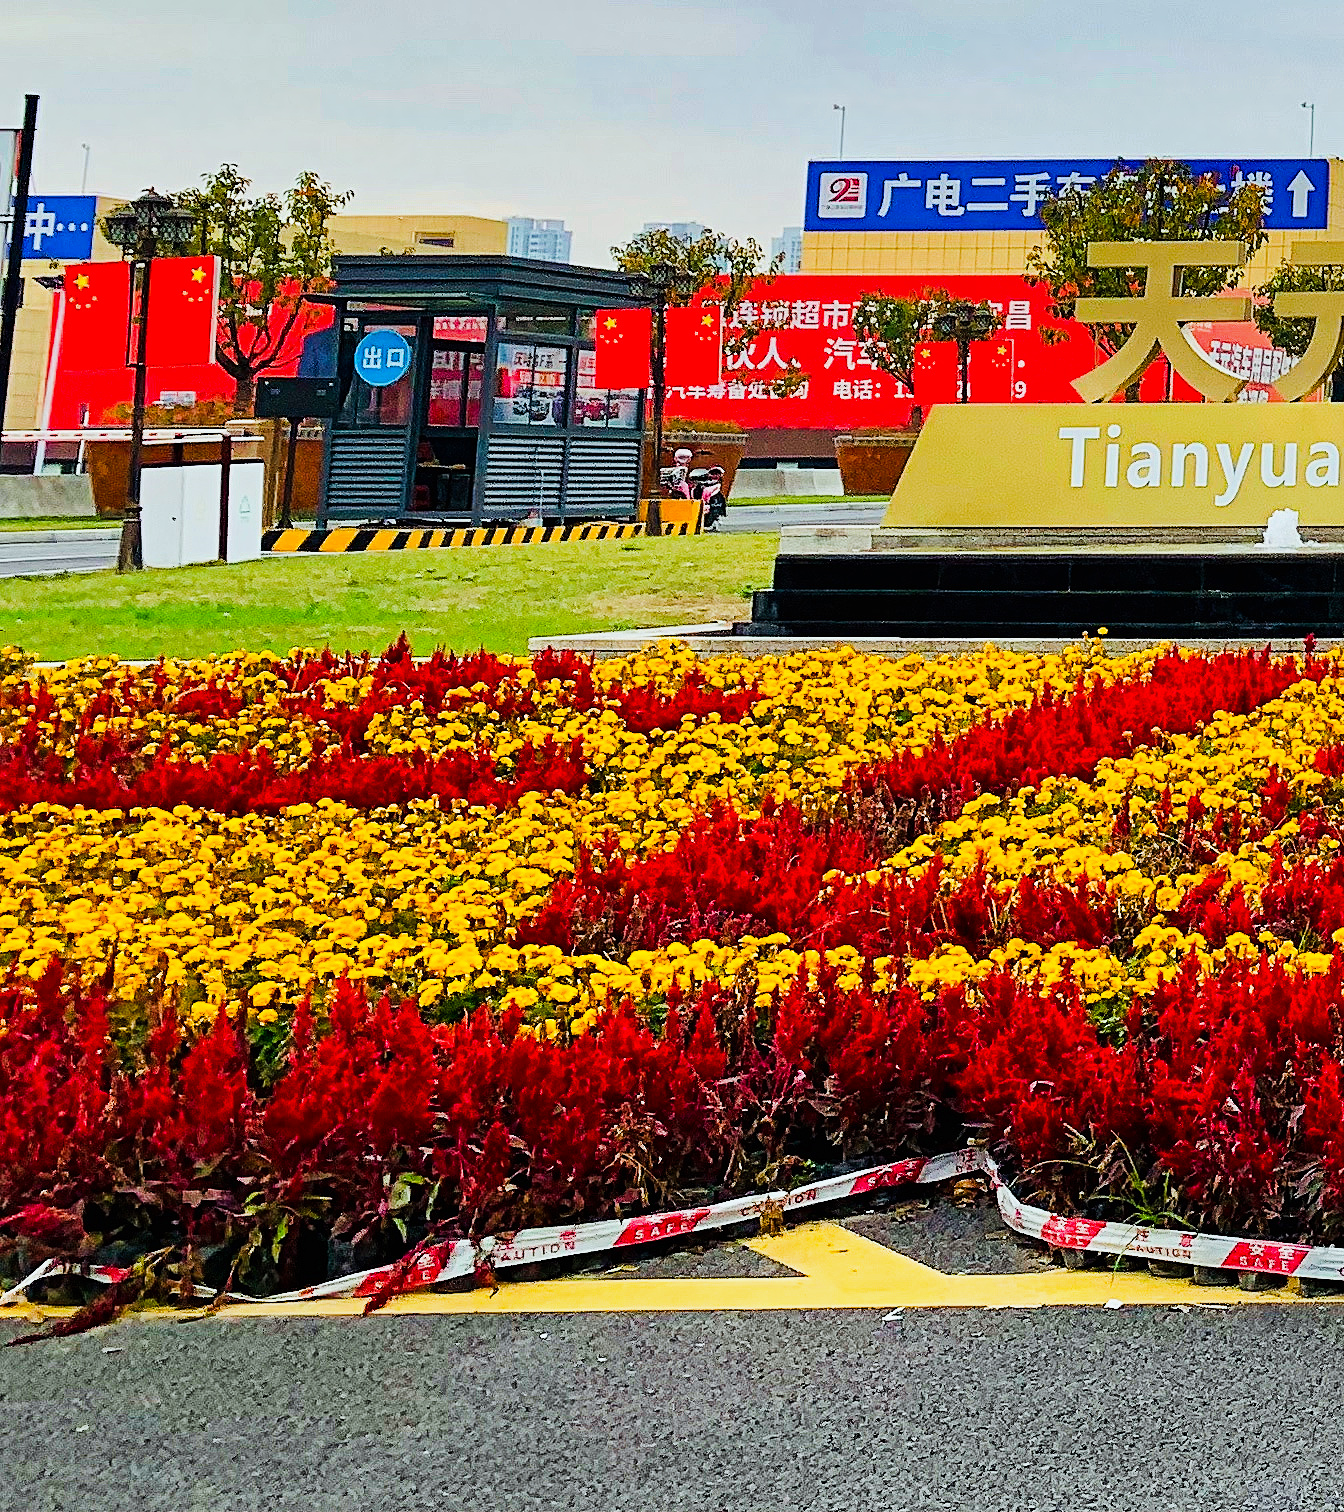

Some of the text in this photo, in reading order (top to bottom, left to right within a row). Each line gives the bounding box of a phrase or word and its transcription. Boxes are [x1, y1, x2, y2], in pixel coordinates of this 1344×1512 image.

[362, 345, 405, 369] 出口
[633, 1221, 690, 1241] SAFE
[496, 1240, 575, 1263] AUTION
[1239, 1255, 1290, 1272] SAFE
